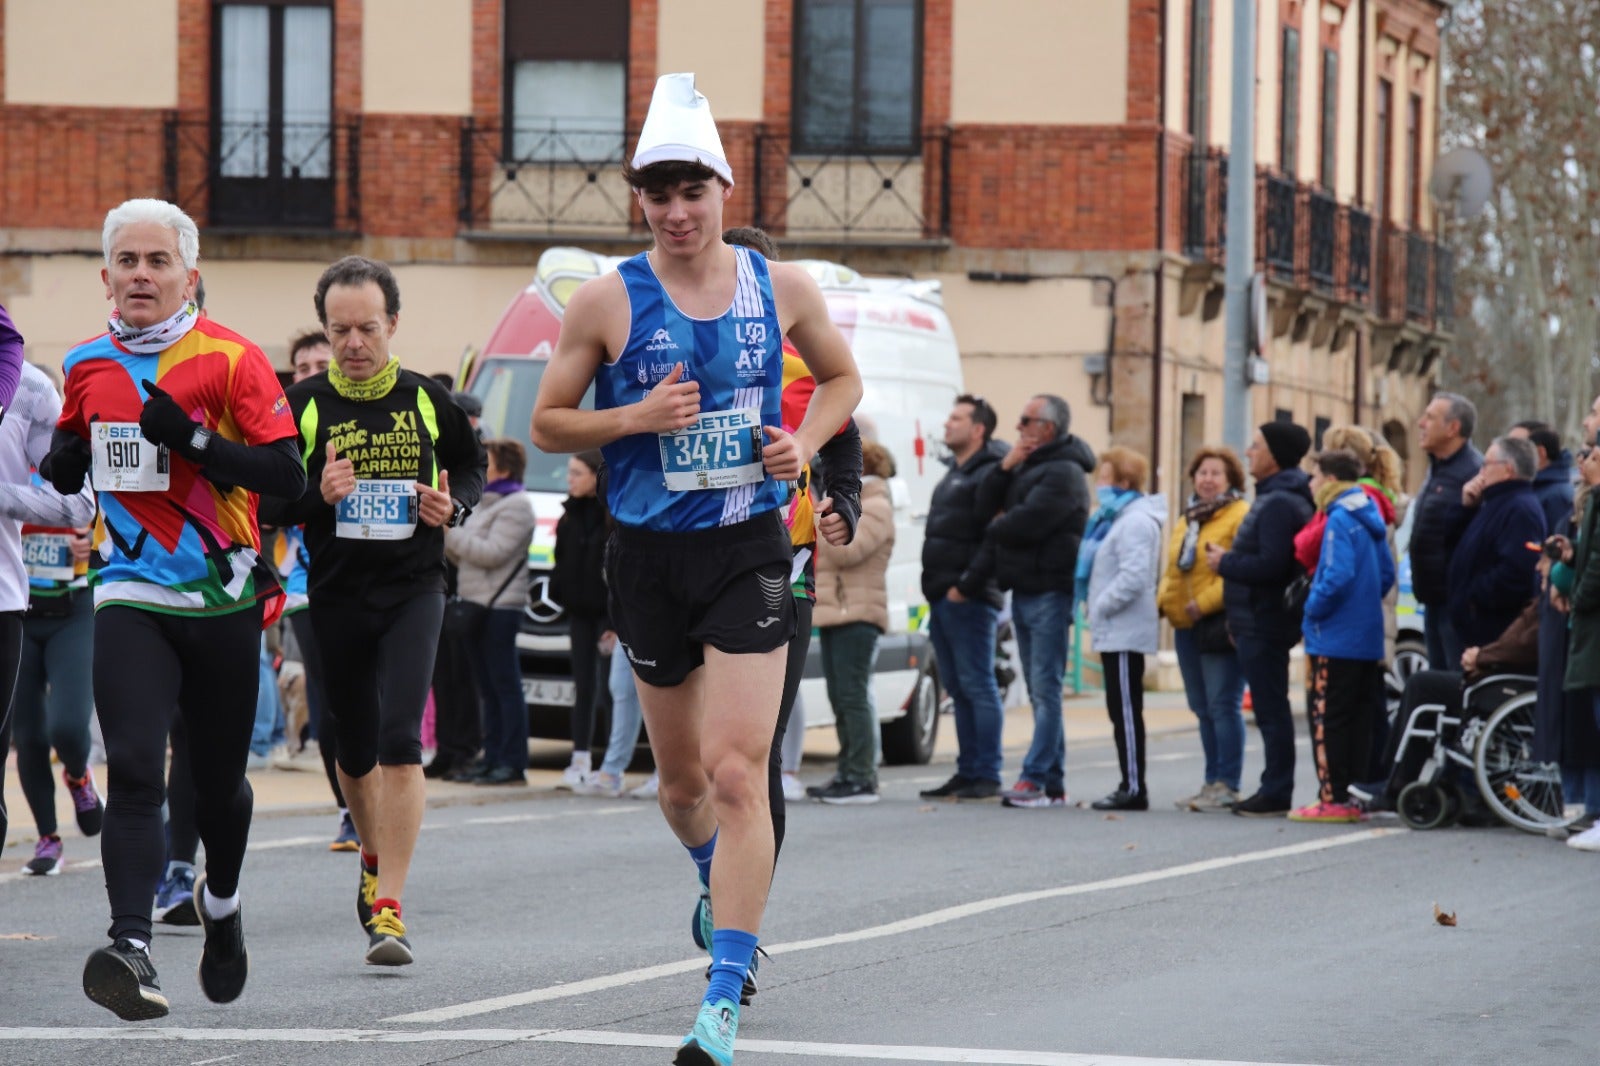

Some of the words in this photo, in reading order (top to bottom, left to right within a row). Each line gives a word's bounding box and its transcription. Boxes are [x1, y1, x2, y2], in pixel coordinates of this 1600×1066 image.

[390, 410, 417, 432] XI
[687, 413, 751, 430] SETEL
[110, 427, 145, 438] SET
[371, 431, 420, 446] MEDIA
[106, 441, 140, 468] 1910
[345, 442, 421, 462] MARATÓN
[673, 430, 741, 467] 3475
[359, 483, 410, 493] SETEL
[346, 496, 399, 520] 3653
